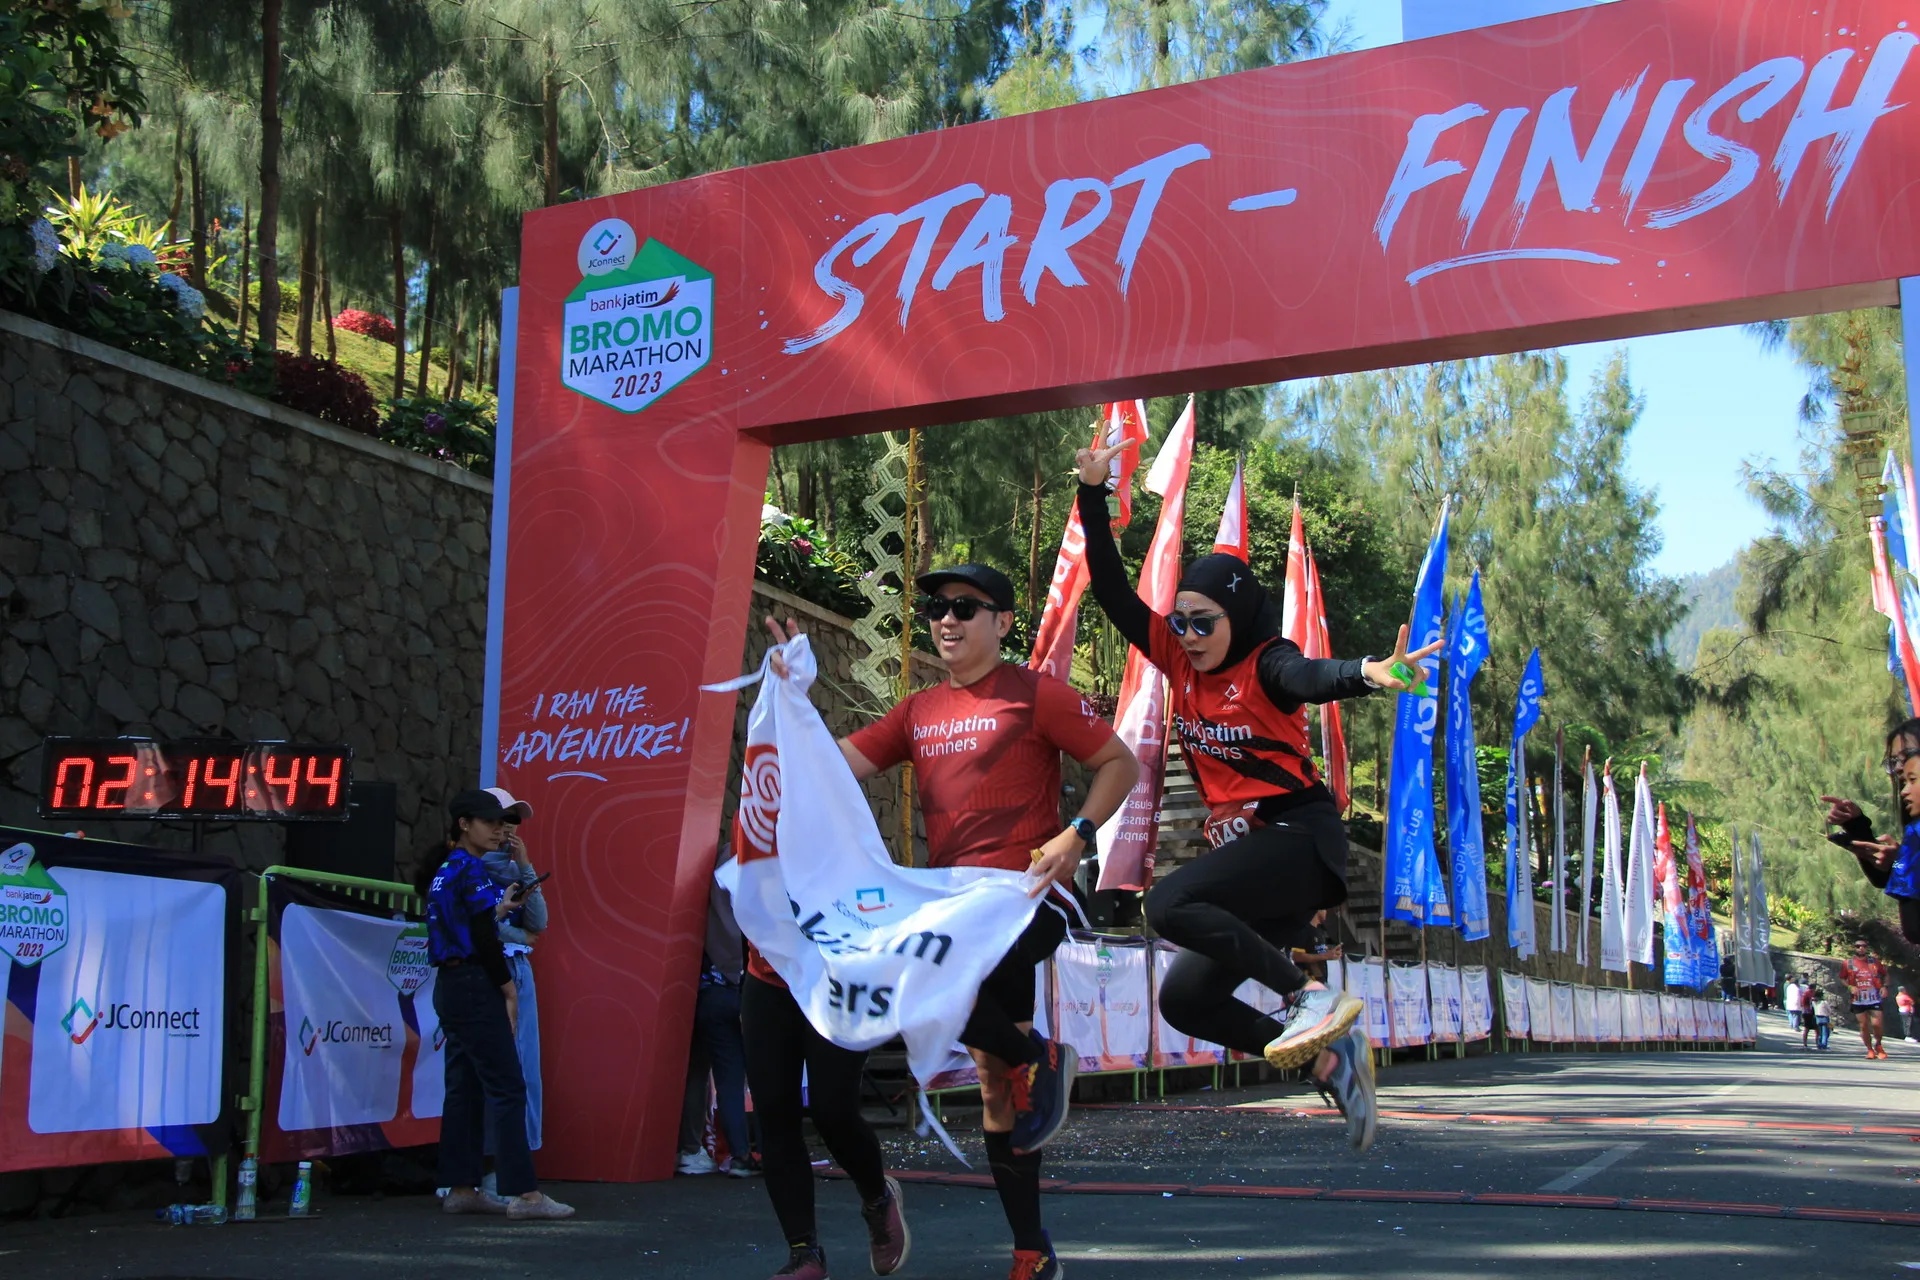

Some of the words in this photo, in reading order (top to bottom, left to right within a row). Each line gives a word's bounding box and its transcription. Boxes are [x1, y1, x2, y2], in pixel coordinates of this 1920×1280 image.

[780, 143, 1212, 355] START
[1372, 32, 1919, 256] FINISH
[588, 255, 626, 268] JConnect
[590, 290, 659, 312] bankjatim
[570, 306, 703, 354] BROMO
[569, 338, 702, 378] MARATHON
[611, 371, 663, 399] 2023
[532, 693, 544, 722] I
[549, 686, 600, 719] RAN
[604, 684, 648, 718] THE
[913, 714, 997, 741] bankjatim
[1176, 716, 1252, 743] ankjatim
[503, 717, 690, 770] ADVENTURE!
[920, 736, 977, 758] runners
[1183, 740, 1243, 760] unners
[52, 756, 341, 809] 02:14:44
[5, 889, 42, 901] bankjatim
[16, 943, 44, 957] 2023
[105, 1003, 200, 1029] JConnect
[322, 1021, 392, 1043] JConnect
